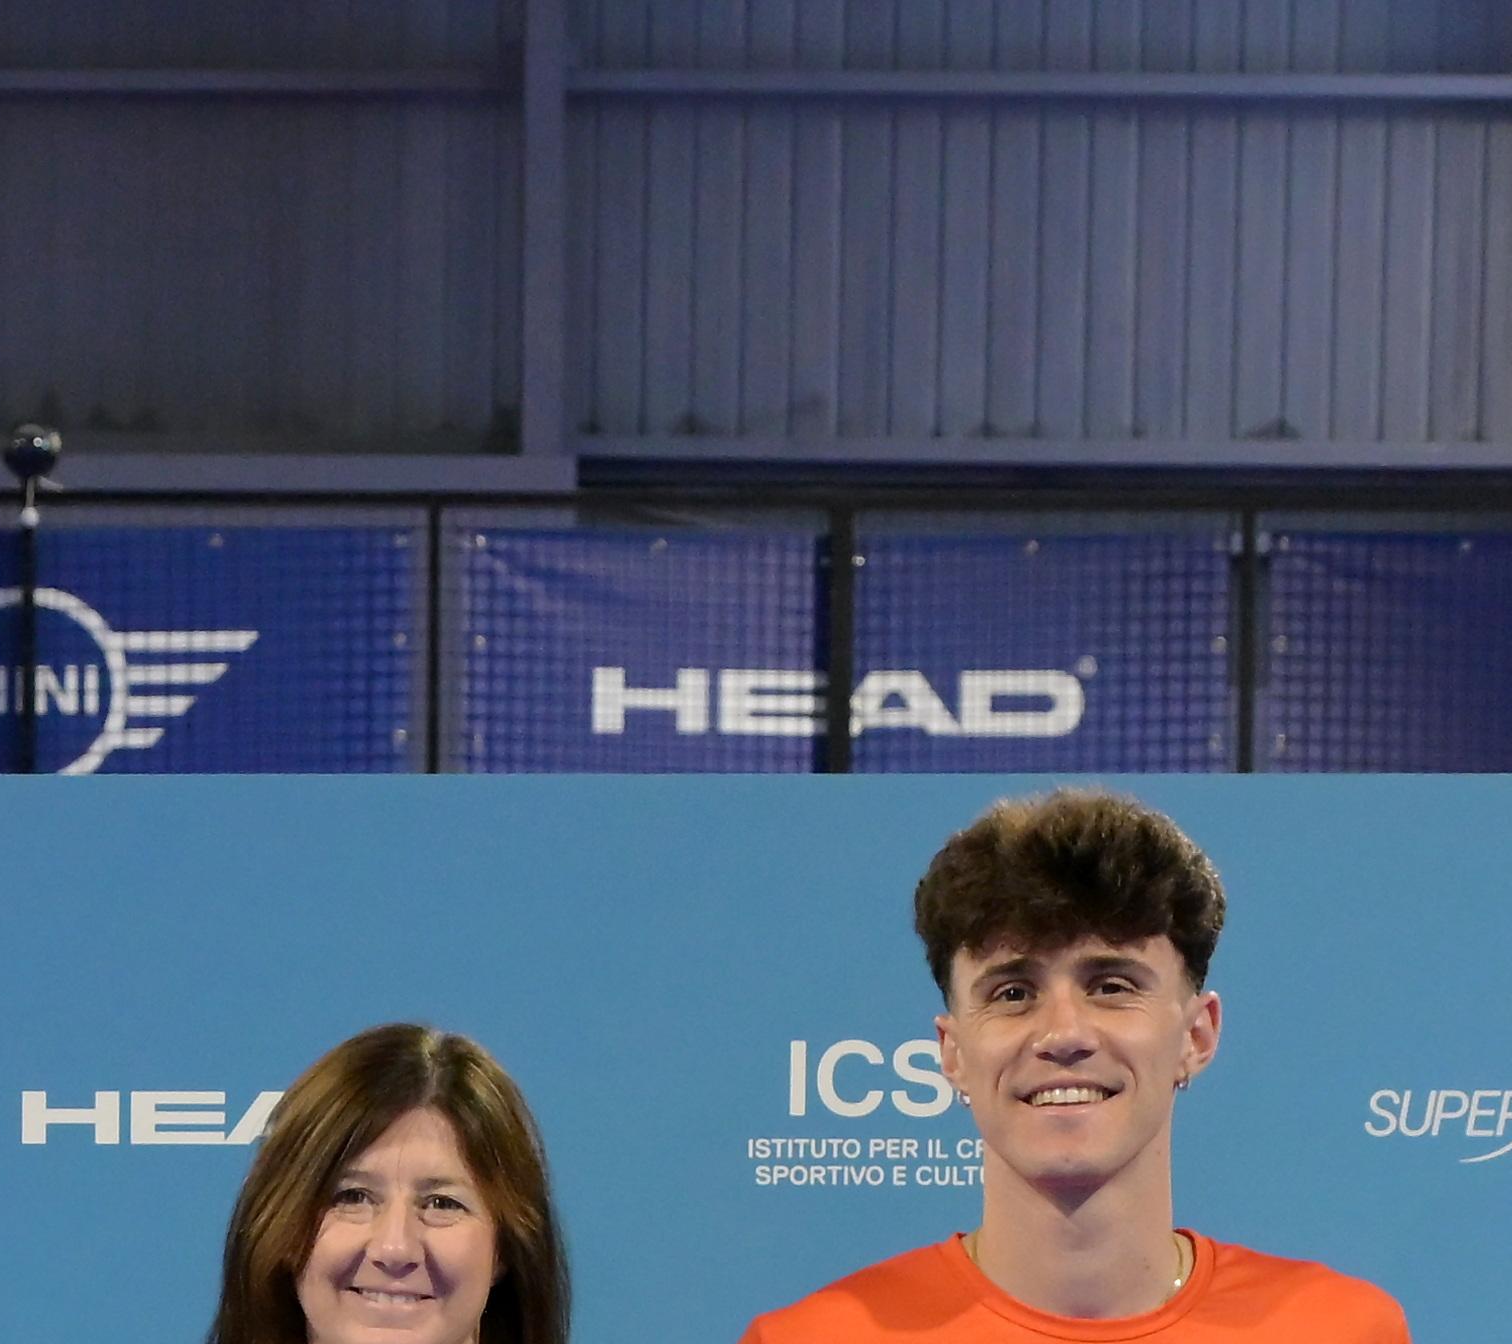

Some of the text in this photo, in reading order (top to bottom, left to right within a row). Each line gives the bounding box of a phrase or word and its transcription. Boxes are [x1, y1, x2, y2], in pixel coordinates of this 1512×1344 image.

[789, 1039, 954, 1117] ICS
[747, 1138, 861, 1159] ISTITUTO
[868, 1138, 919, 1159] PER
[927, 1138, 949, 1159] IL
[755, 1165, 885, 1186] SPORTIVO
[892, 1166, 907, 1186] E
